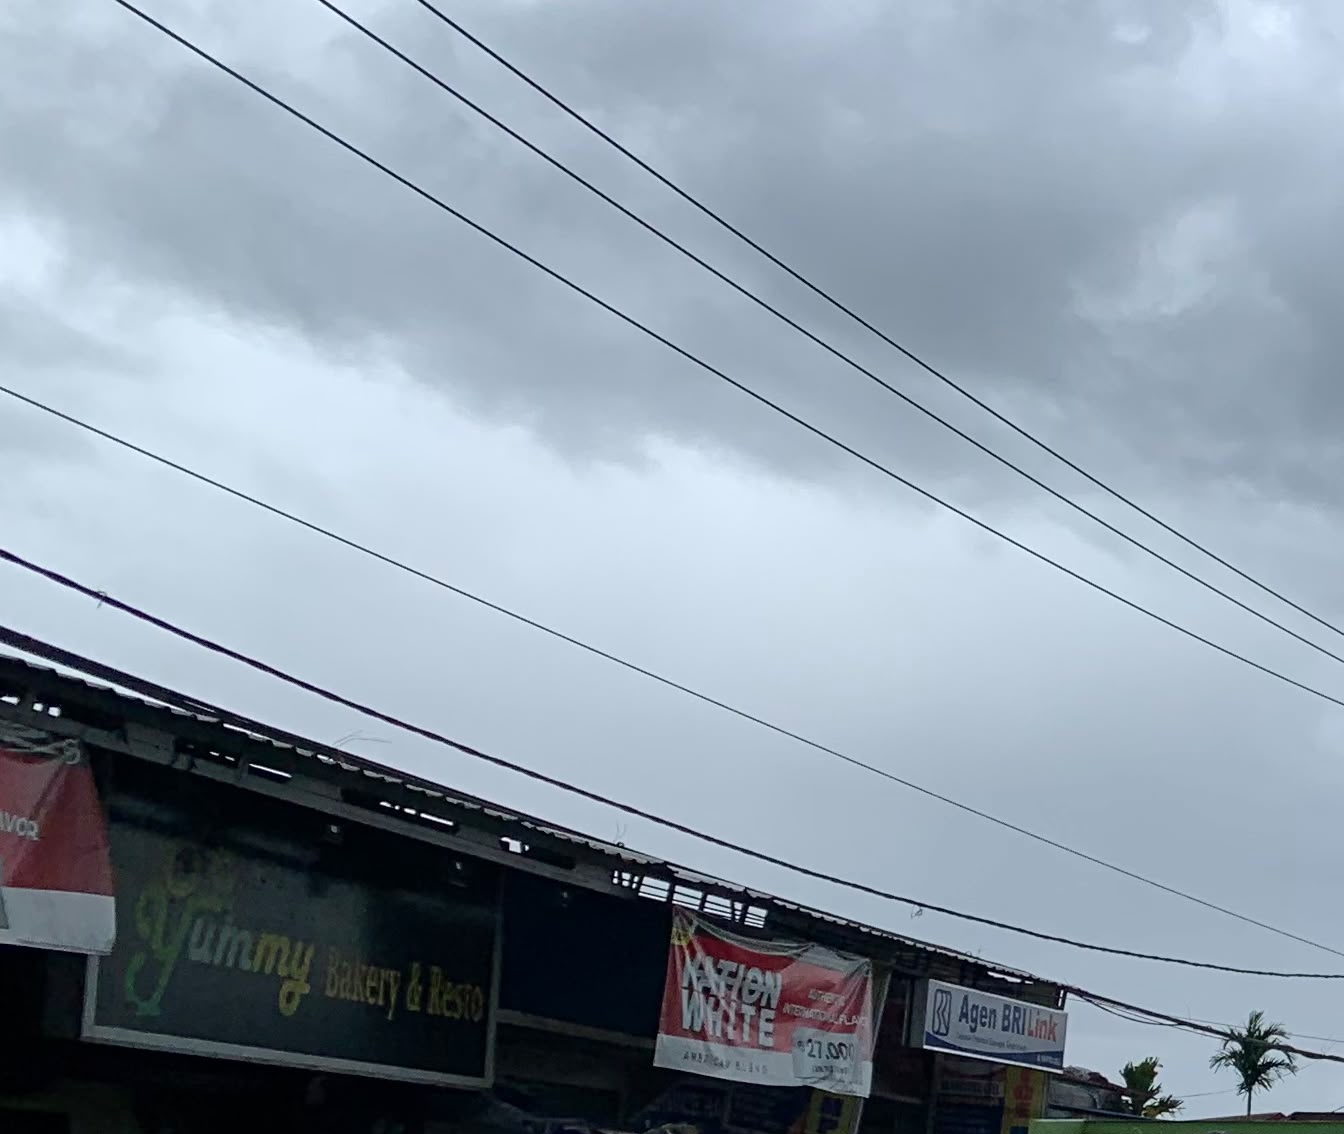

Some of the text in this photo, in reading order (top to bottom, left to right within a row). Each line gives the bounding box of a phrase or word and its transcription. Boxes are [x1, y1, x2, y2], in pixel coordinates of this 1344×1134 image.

[124, 878, 484, 1022] Yummy Bakery & Resto
[682, 957, 783, 1009] NATION
[682, 986, 777, 1047] WHITE
[959, 994, 997, 1033] Agen
